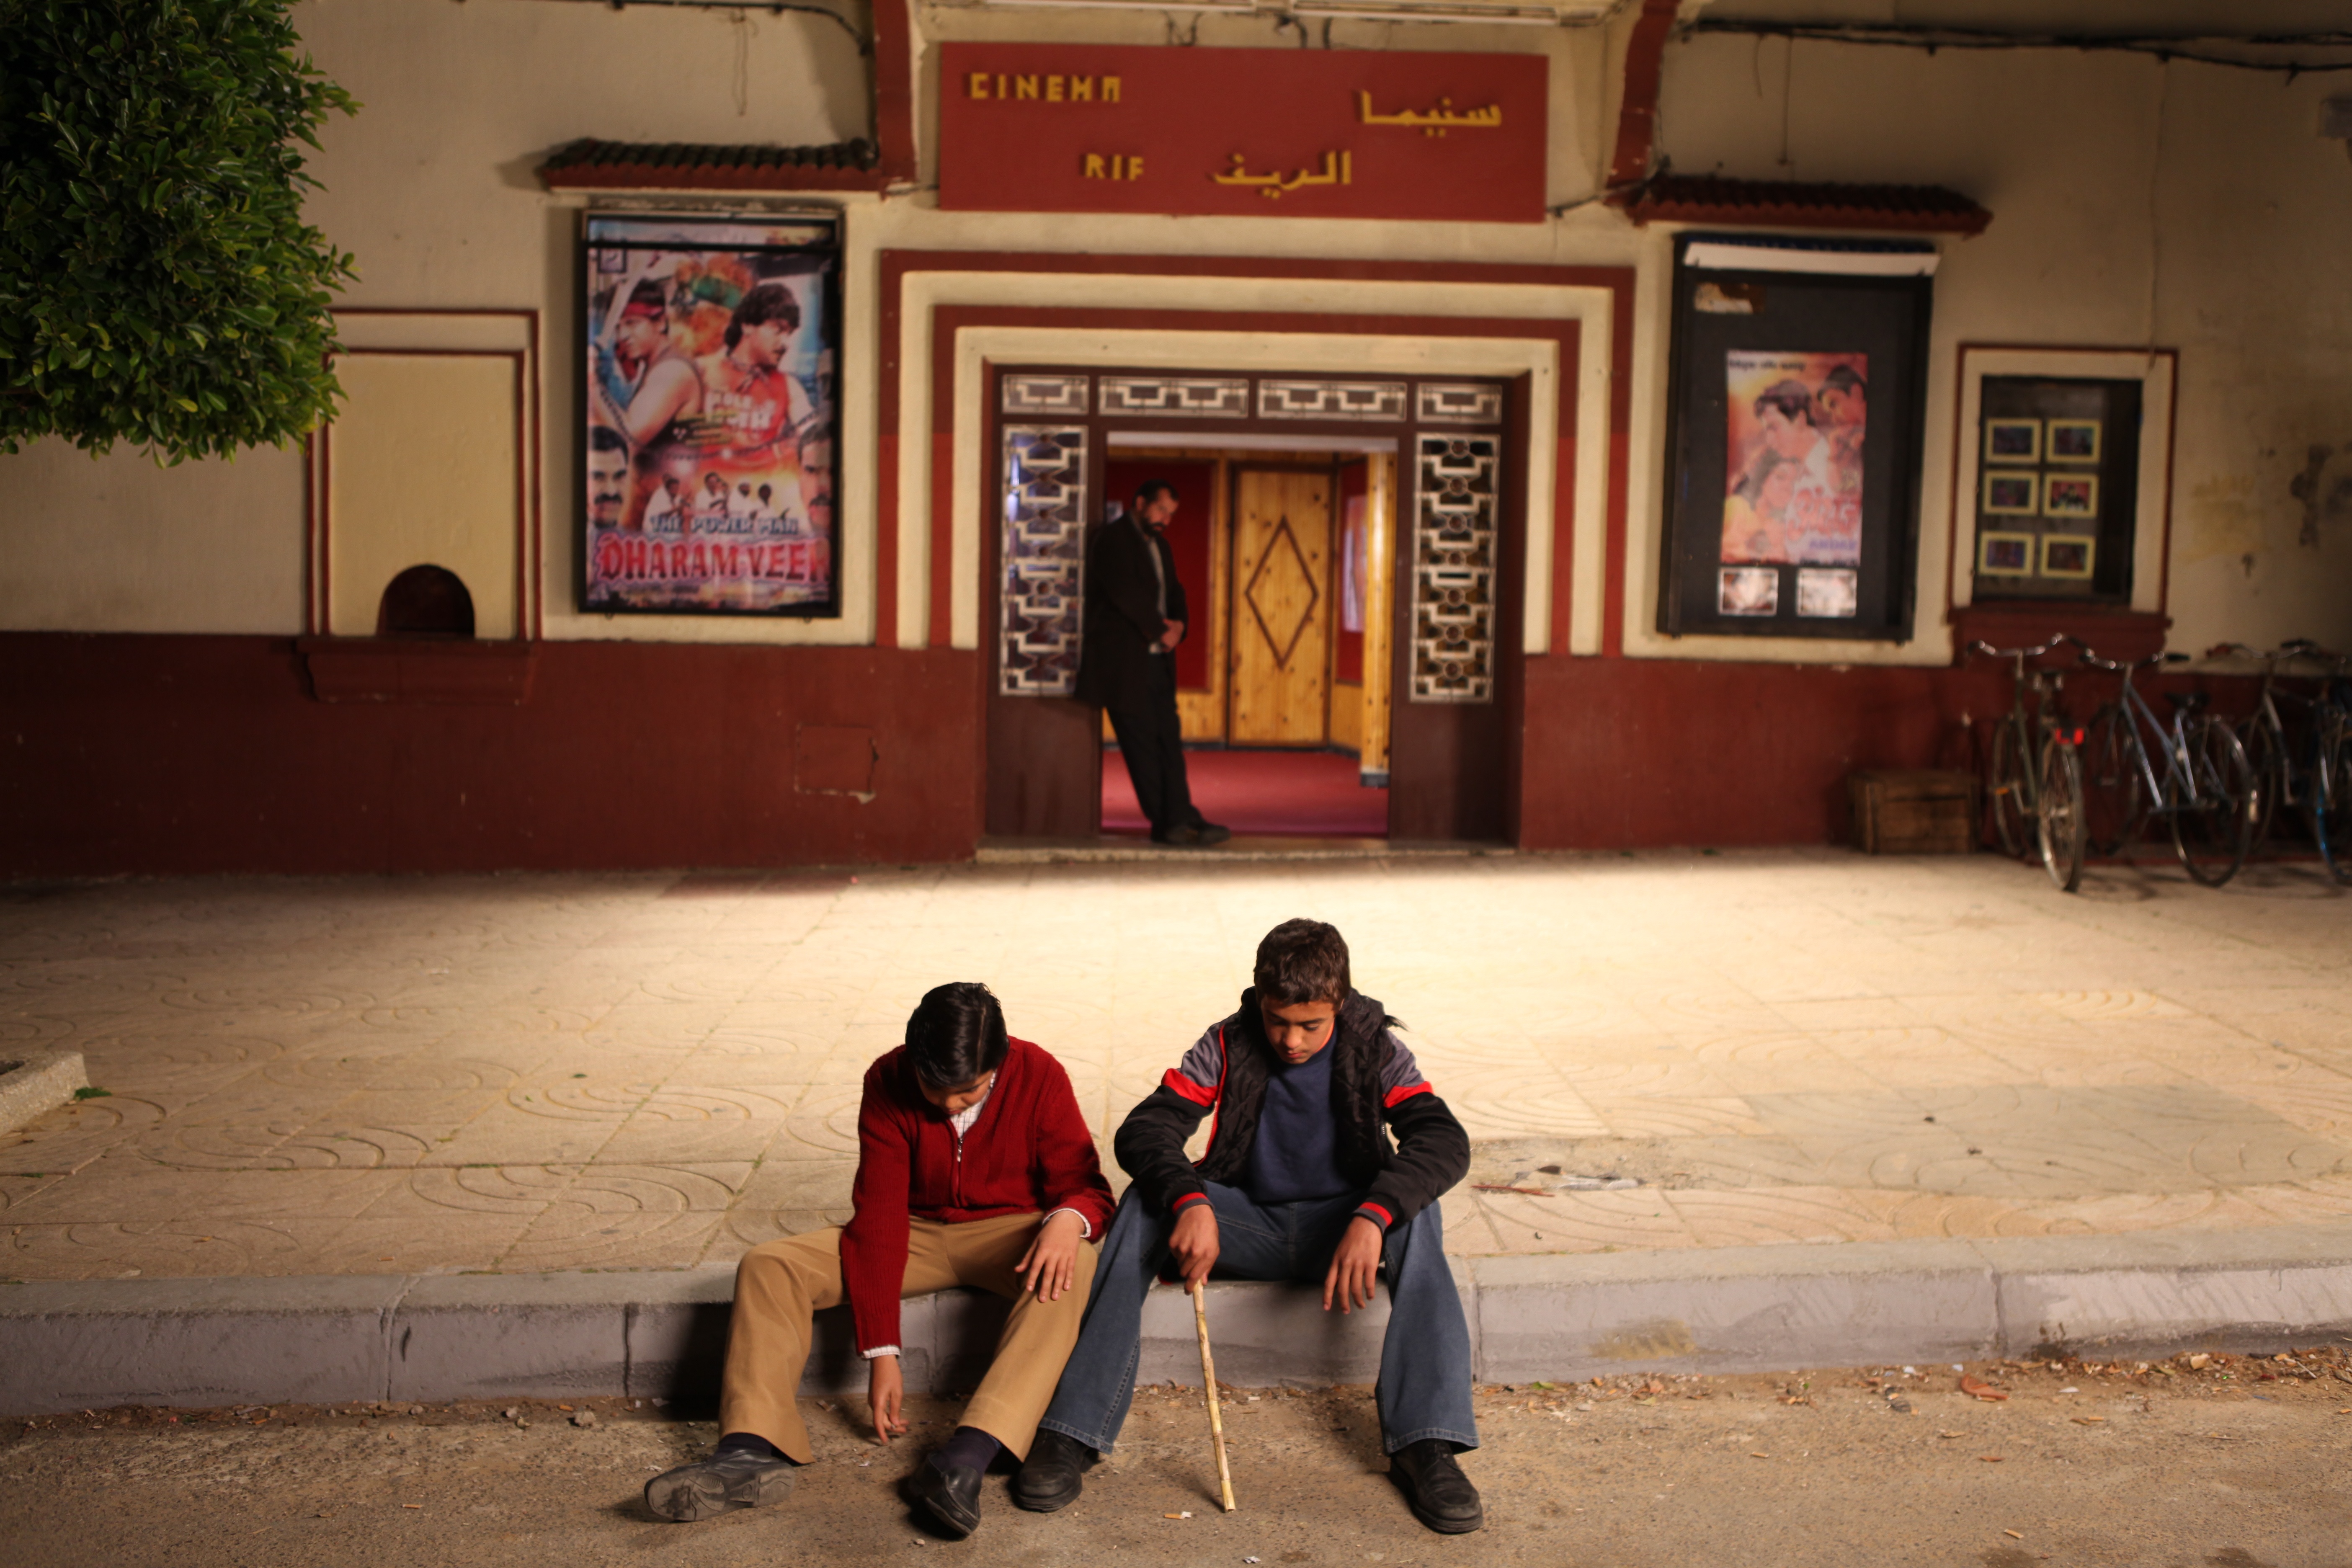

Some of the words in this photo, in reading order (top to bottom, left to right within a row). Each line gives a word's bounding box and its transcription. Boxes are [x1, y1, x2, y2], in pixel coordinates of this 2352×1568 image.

[970, 72, 1121, 103] CINEMA
[1085, 152, 1144, 181] RIF
[1214, 150, 1352, 199] الريف
